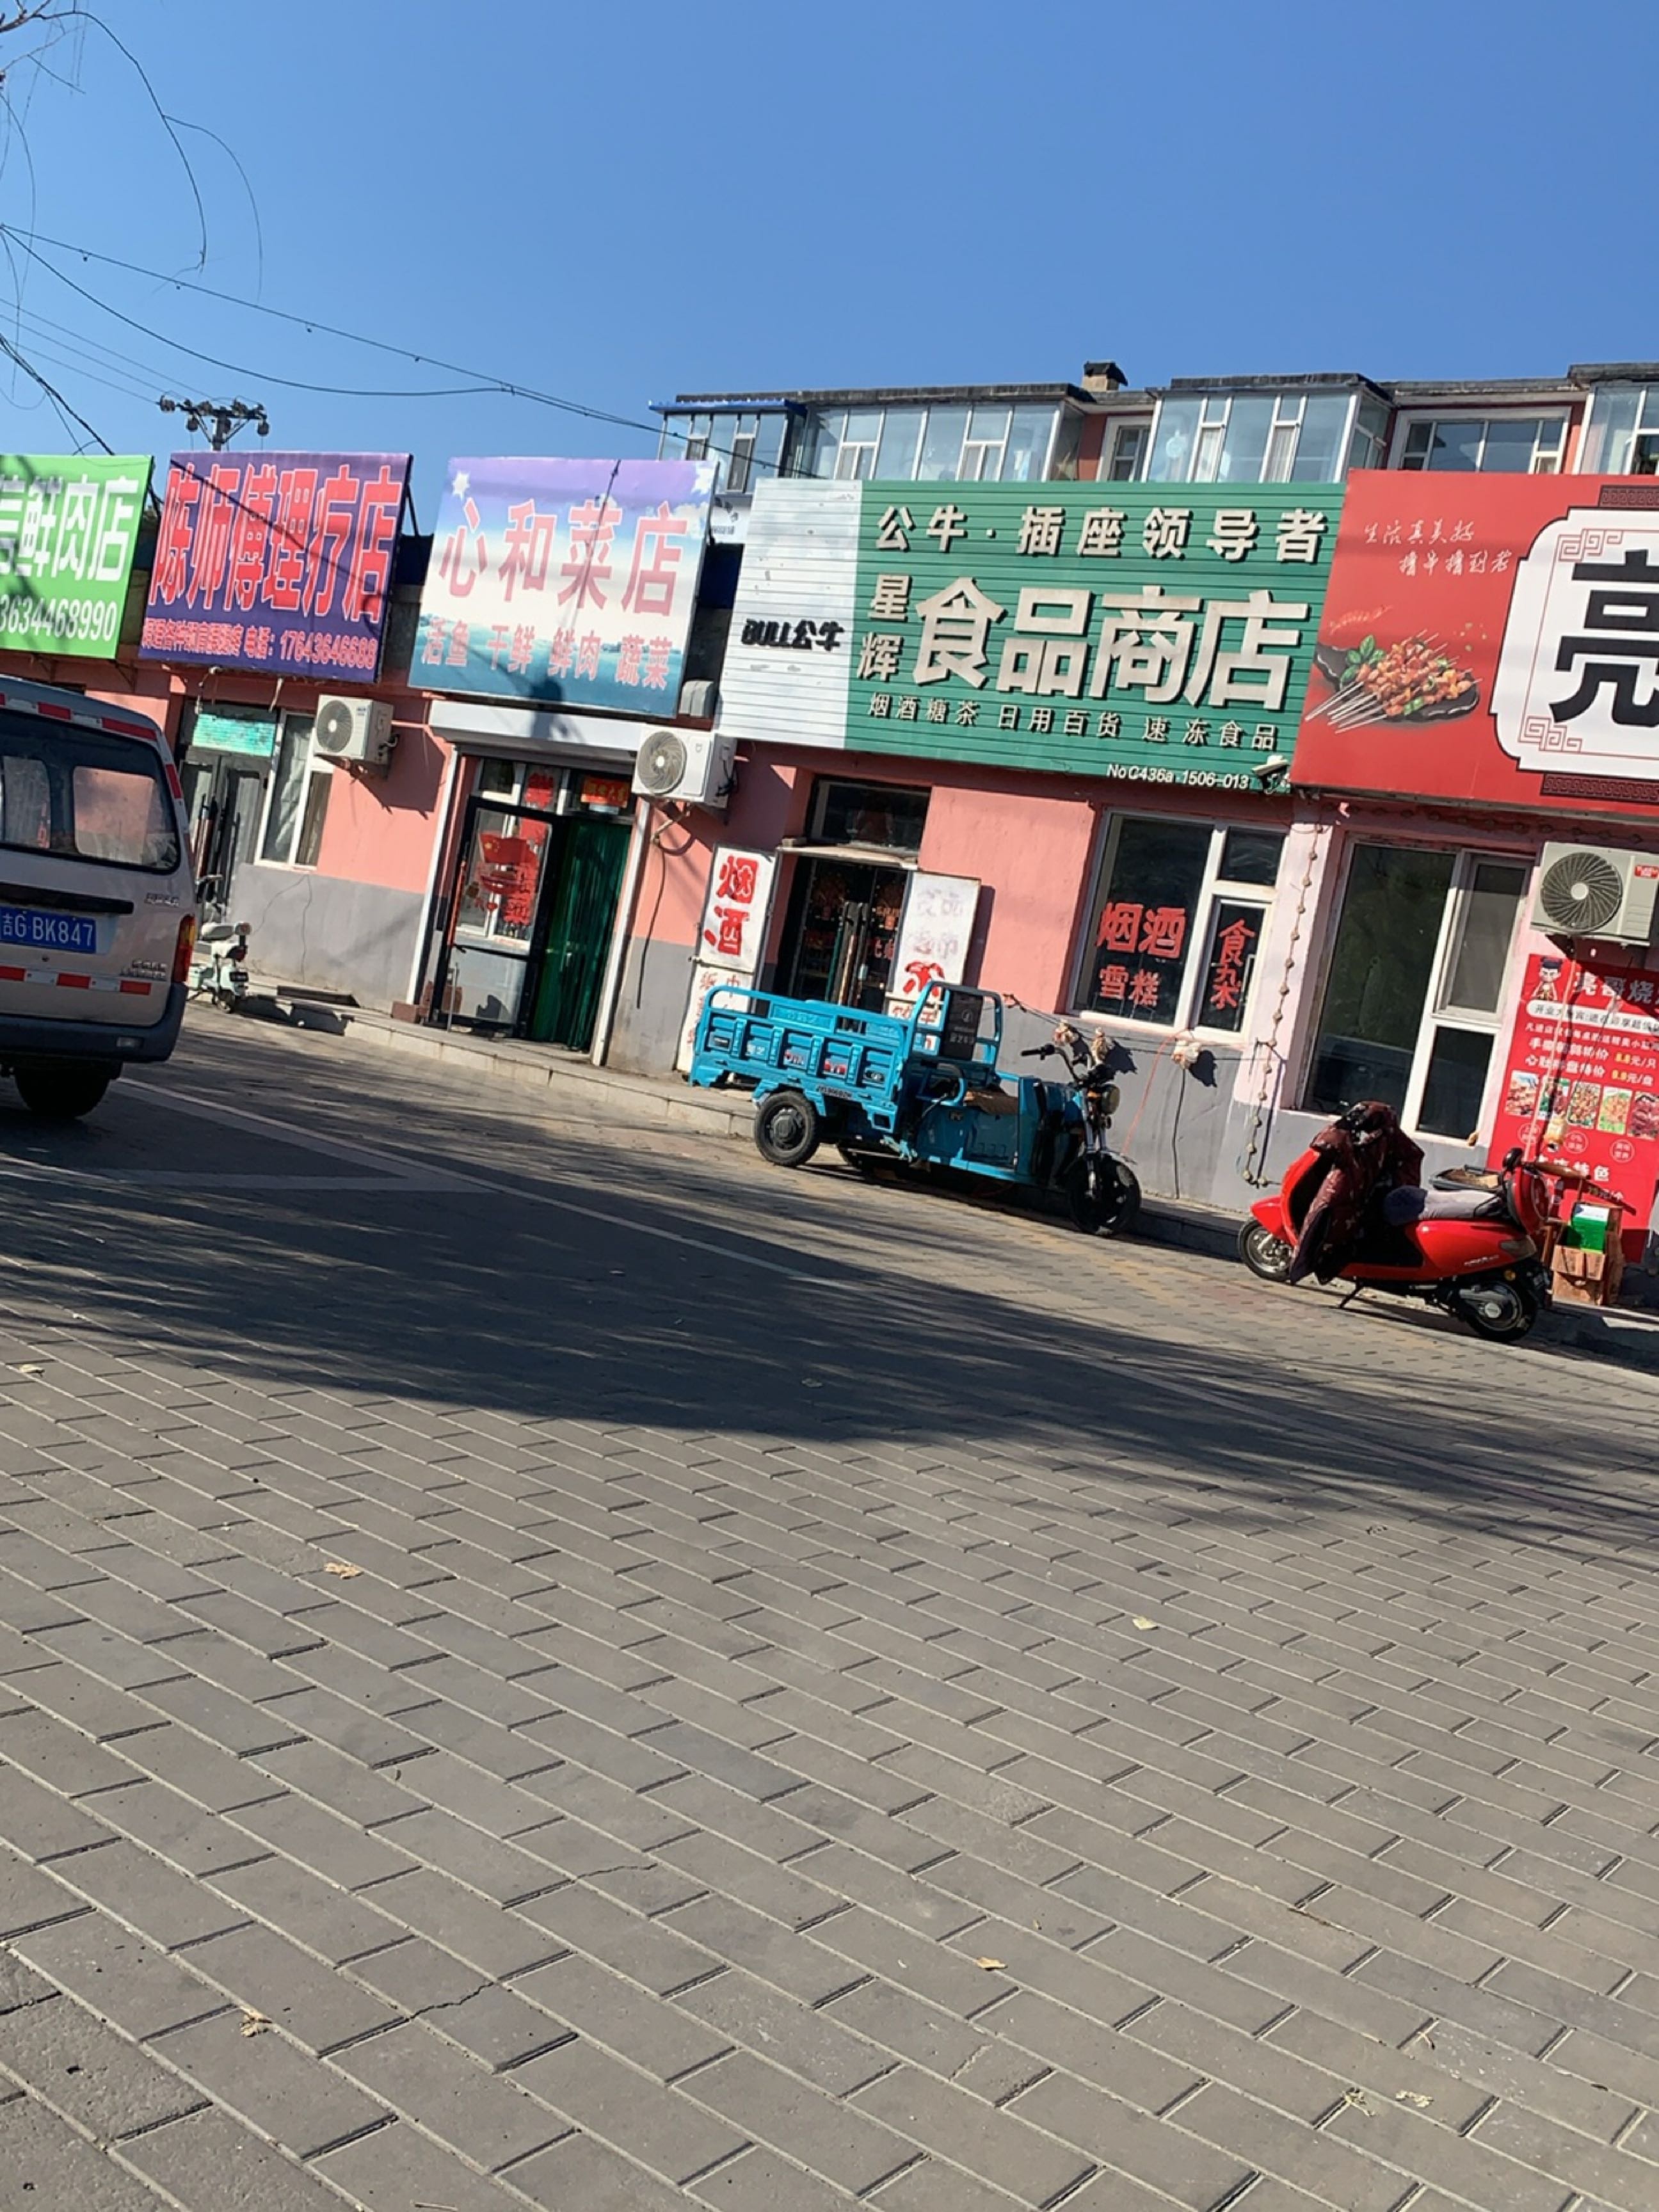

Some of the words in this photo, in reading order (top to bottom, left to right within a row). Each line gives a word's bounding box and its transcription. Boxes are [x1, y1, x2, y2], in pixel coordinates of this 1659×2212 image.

[148, 462, 403, 623] 陈师傅理疗店
[438, 497, 689, 618] 心和菜店
[422, 617, 469, 667] 活鱼
[487, 623, 536, 675] 干鲜
[547, 627, 602, 681] 鲜肉
[615, 633, 673, 691] 蔬菜
[856, 573, 913, 681] 星辉
[912, 577, 1310, 712] 食品商店
[867, 692, 980, 726] 烟酒糖茶
[997, 703, 1121, 740] 日用百货
[1141, 716, 1279, 752] 速冻食品
[705, 854, 760, 957] 烟酒
[1096, 901, 1187, 959] 烟酒
[1098, 964, 1161, 1007] 雪糕
[1210, 918, 1255, 1009] 食杂
[1573, 970, 1659, 1005] 亮哥烧
